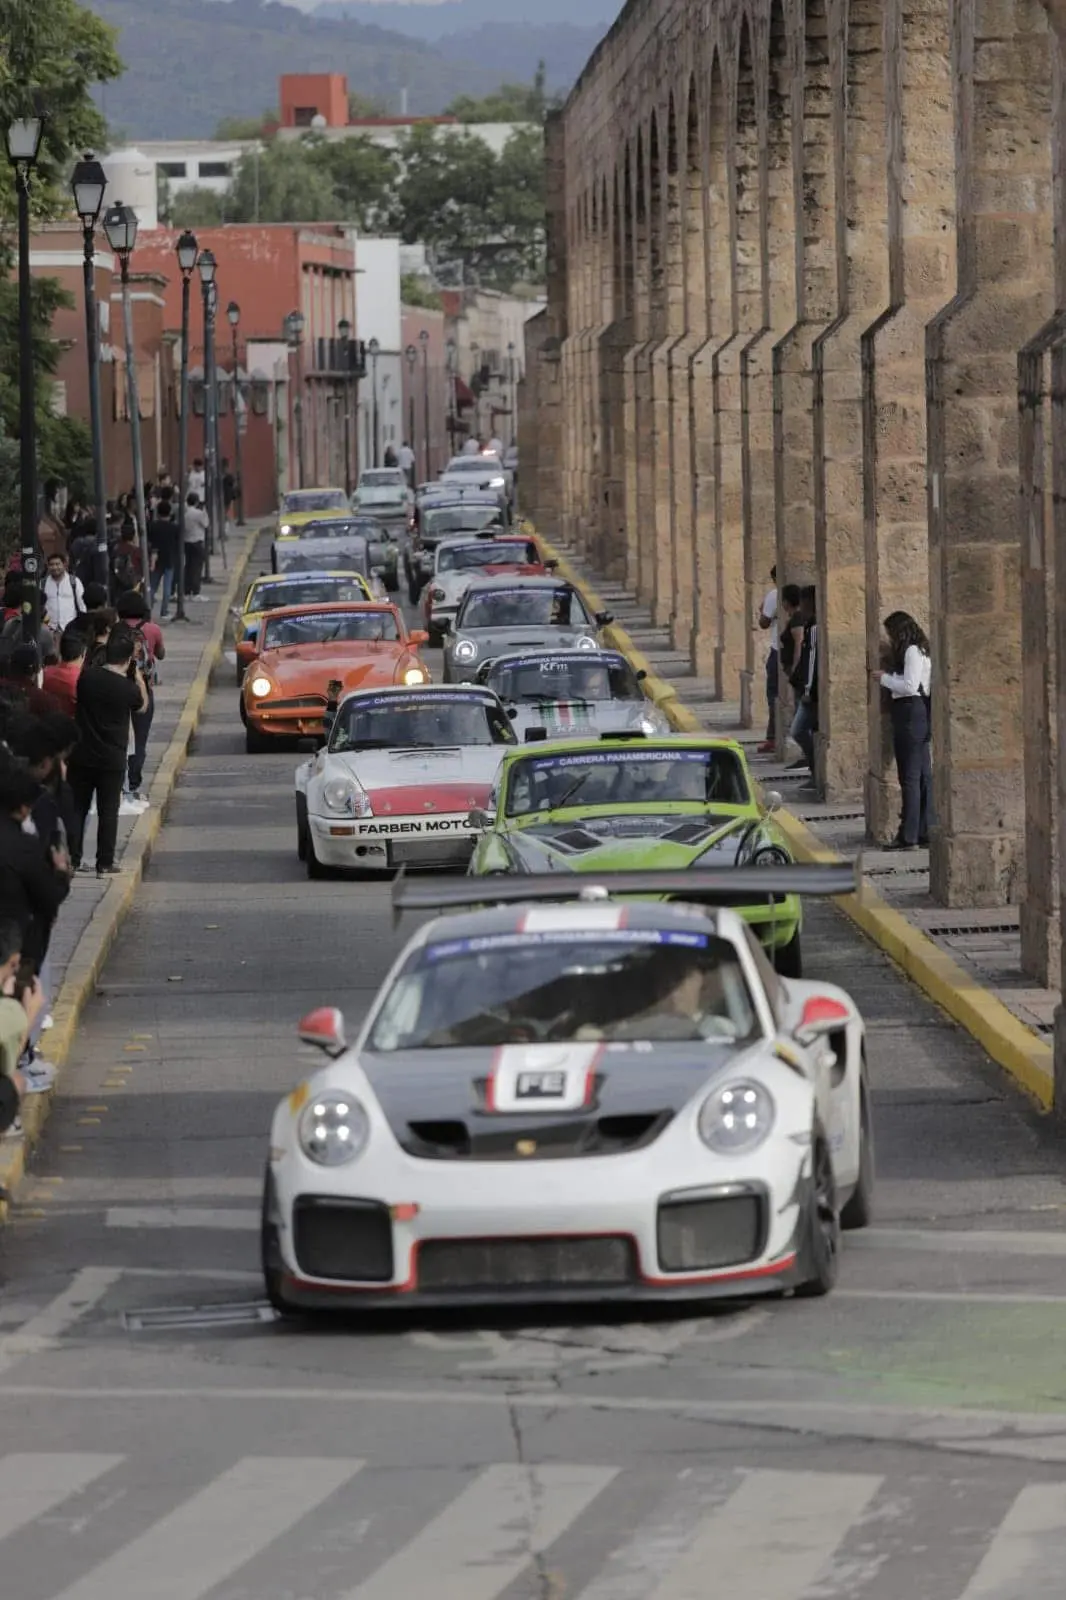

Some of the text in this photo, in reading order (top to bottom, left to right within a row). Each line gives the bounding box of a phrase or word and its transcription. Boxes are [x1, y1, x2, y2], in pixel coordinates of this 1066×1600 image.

[519, 656, 550, 666] CARRERA
[551, 655, 603, 663] PANAMERICANA
[374, 695, 409, 705] CARRERA
[411, 692, 471, 702] PANAMERICANA
[559, 754, 605, 767] CARRERA
[607, 752, 682, 763] PANAMERICANA
[359, 817, 495, 834] FARBEN MOTOS
[469, 932, 542, 950] CARRERA
[543, 928, 663, 945] PANAMERICANA
